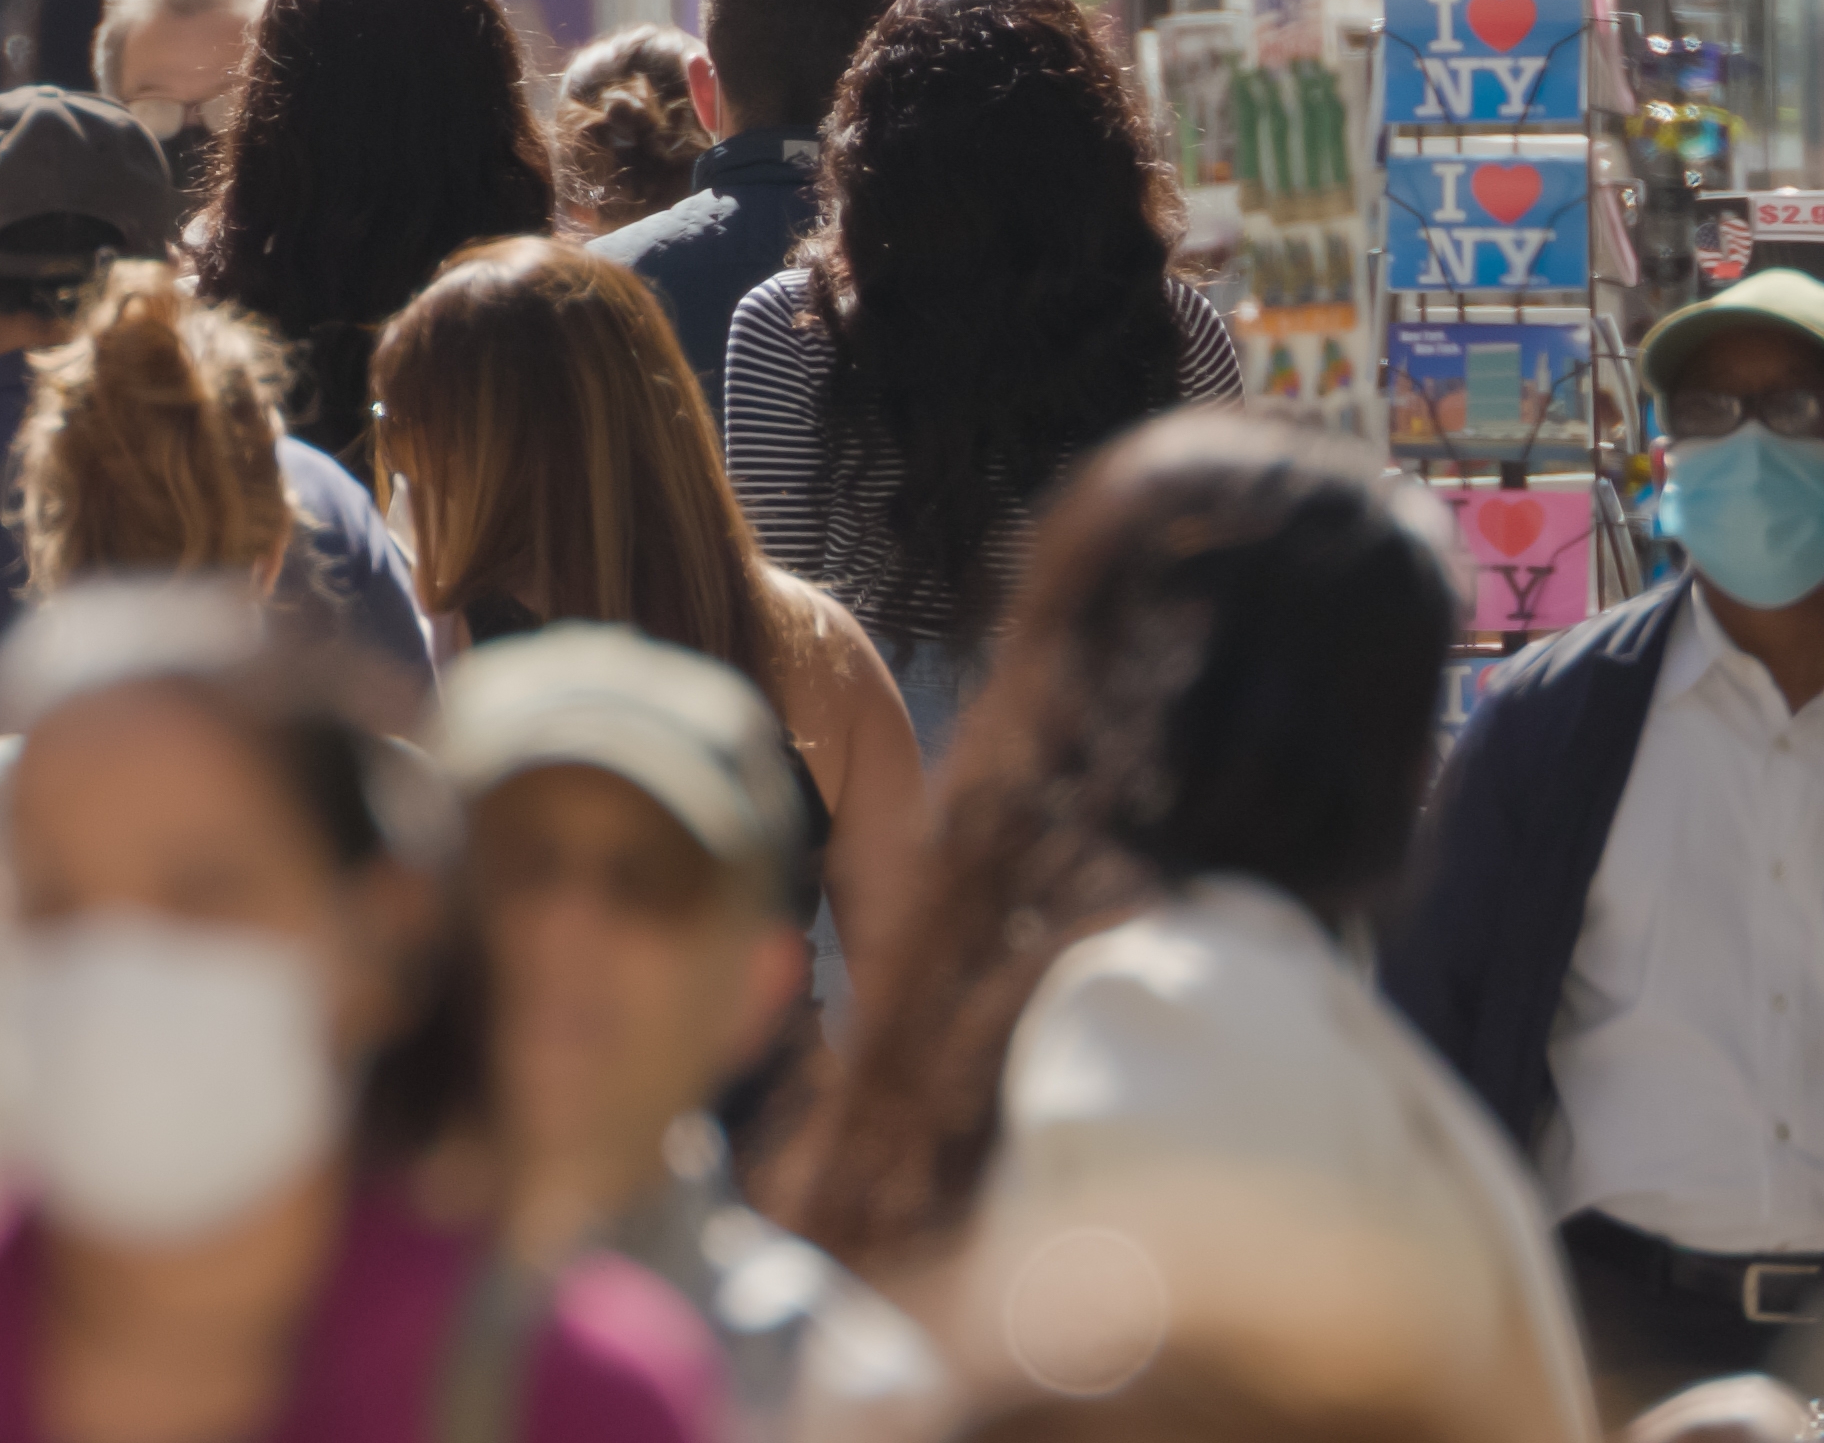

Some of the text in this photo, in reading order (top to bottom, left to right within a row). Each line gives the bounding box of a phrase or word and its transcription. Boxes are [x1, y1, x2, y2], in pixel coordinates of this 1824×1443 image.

[1414, 57, 1549, 118] NY
[1432, 163, 1467, 224] I
[1418, 227, 1558, 286] NY
